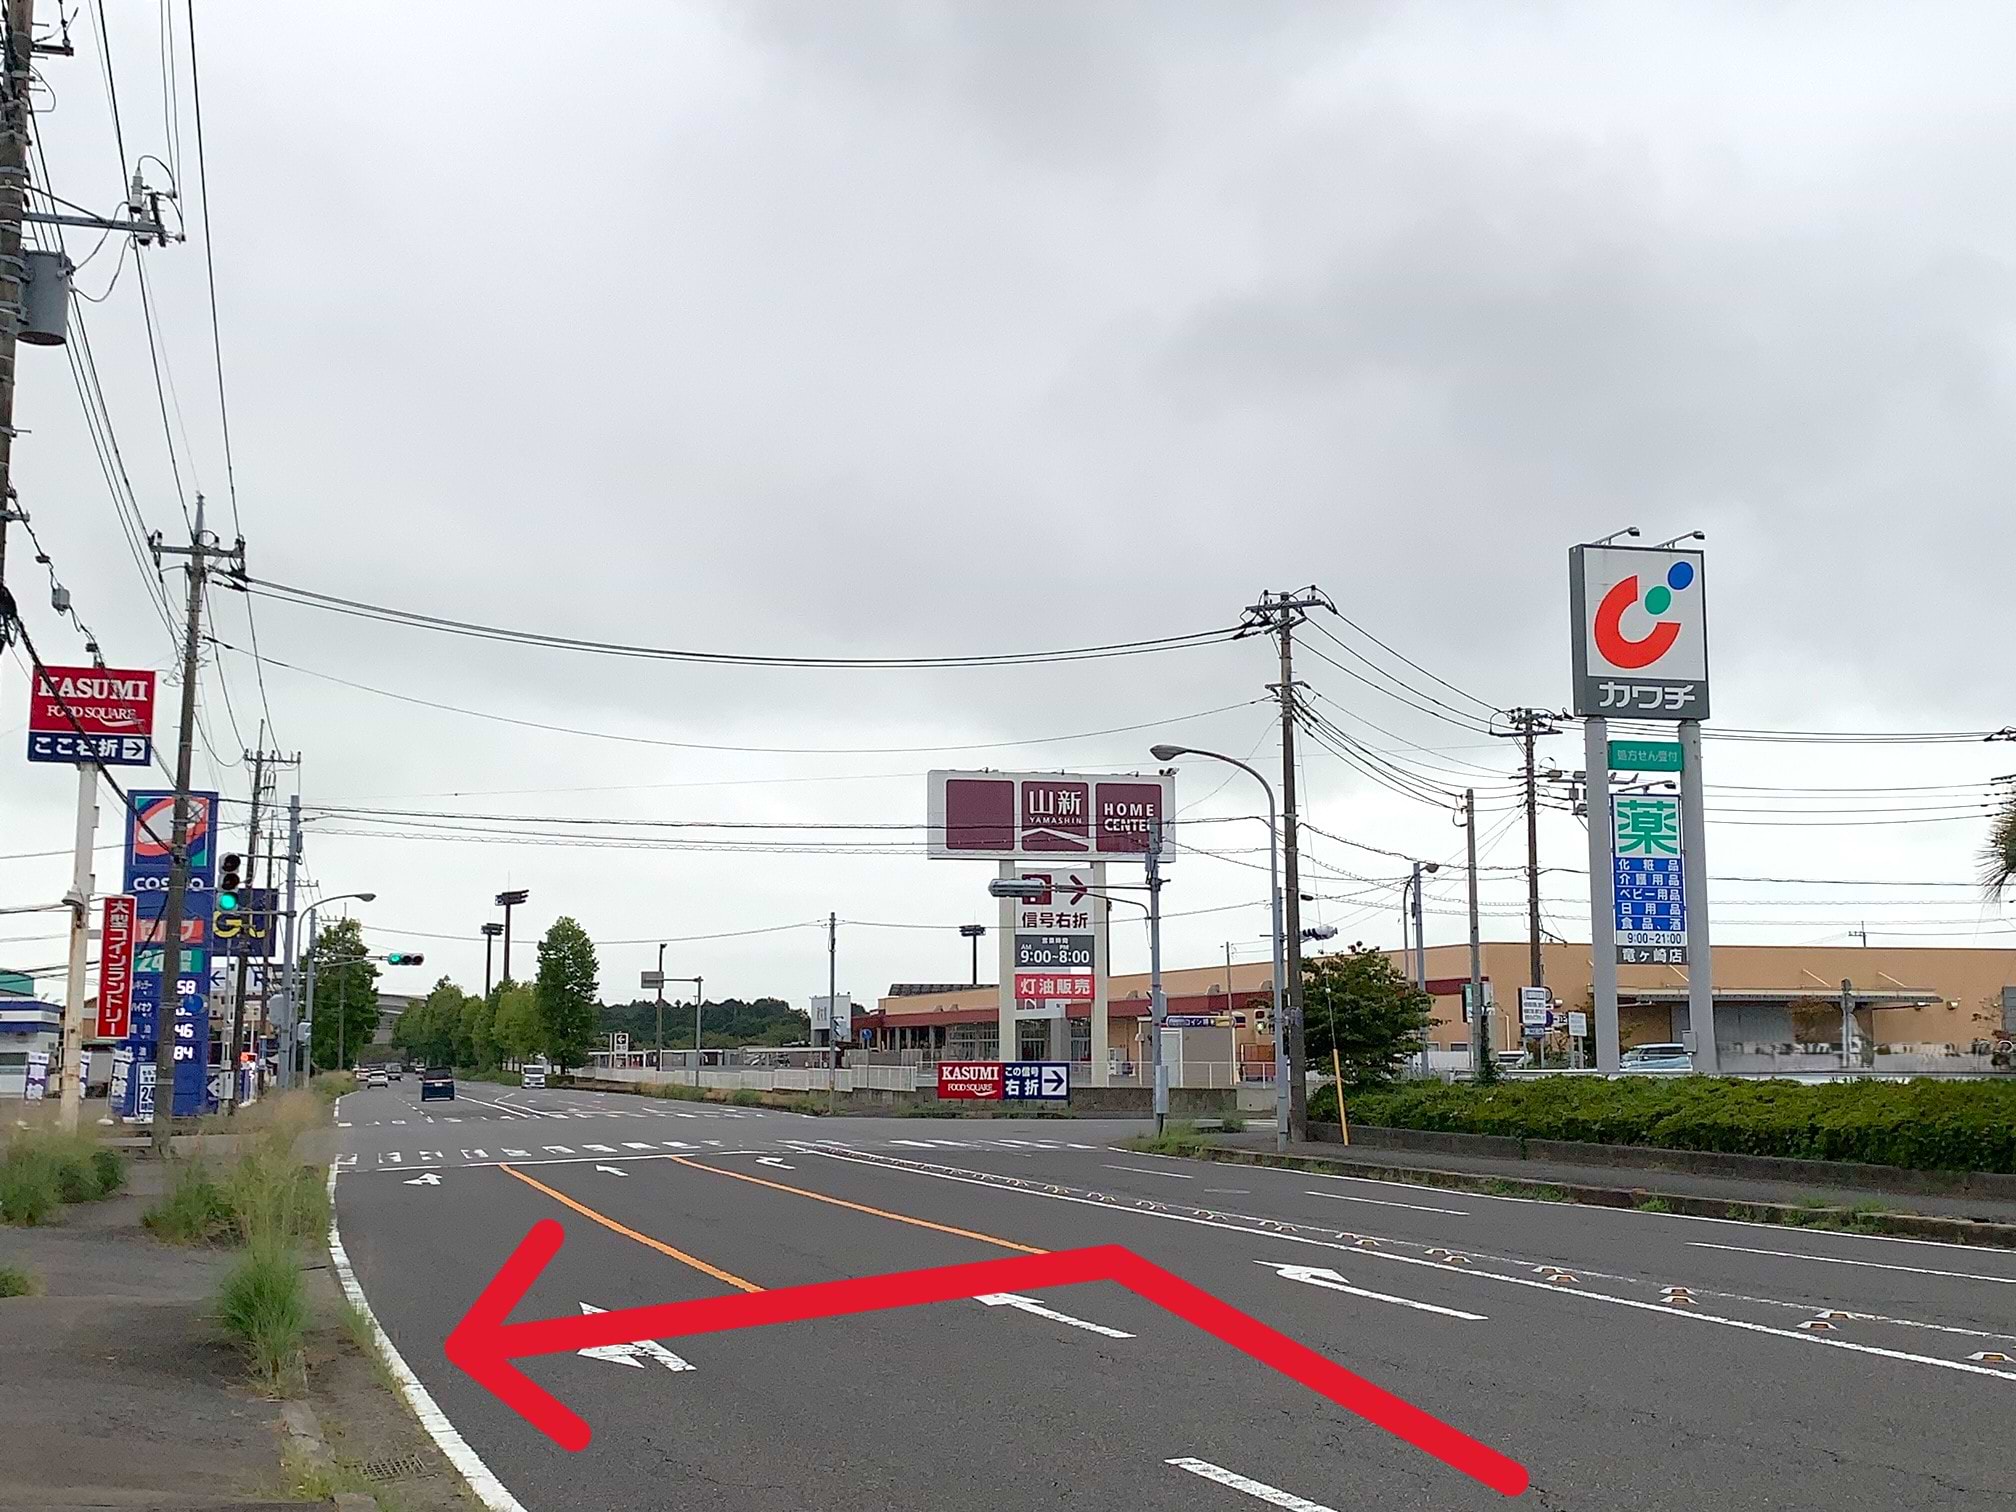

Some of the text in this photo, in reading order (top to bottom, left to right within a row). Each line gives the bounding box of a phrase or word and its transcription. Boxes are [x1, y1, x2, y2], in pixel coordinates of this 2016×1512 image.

[38, 675, 149, 701] KASUMI
[1598, 681, 1696, 711] カワチ
[85, 706, 137, 721] SQUARE
[34, 737, 119, 758] ここ右折
[1616, 748, 1678, 764] 処方せん受付
[1029, 789, 1083, 815] 山新
[1104, 803, 1155, 816] HOME
[1104, 819, 1149, 832] CENTE
[1616, 799, 1679, 855] 薬
[1618, 858, 1680, 872] 化粧品
[133, 876, 204, 891] COSO
[1618, 873, 1680, 887] 介護用品
[1619, 887, 1681, 901] ベビー用品
[1620, 902, 1681, 916] 日用品
[1021, 912, 1089, 929] 信号右折
[106, 900, 130, 1035] 大型コインランドリー
[1020, 979, 1090, 995] 灯油販売
[941, 1066, 1000, 1081] KASUMI
[1005, 1067, 1039, 1077] この信号
[947, 1084, 995, 1094] FOOD SQUARE
[1005, 1079, 1039, 1096] 右折
